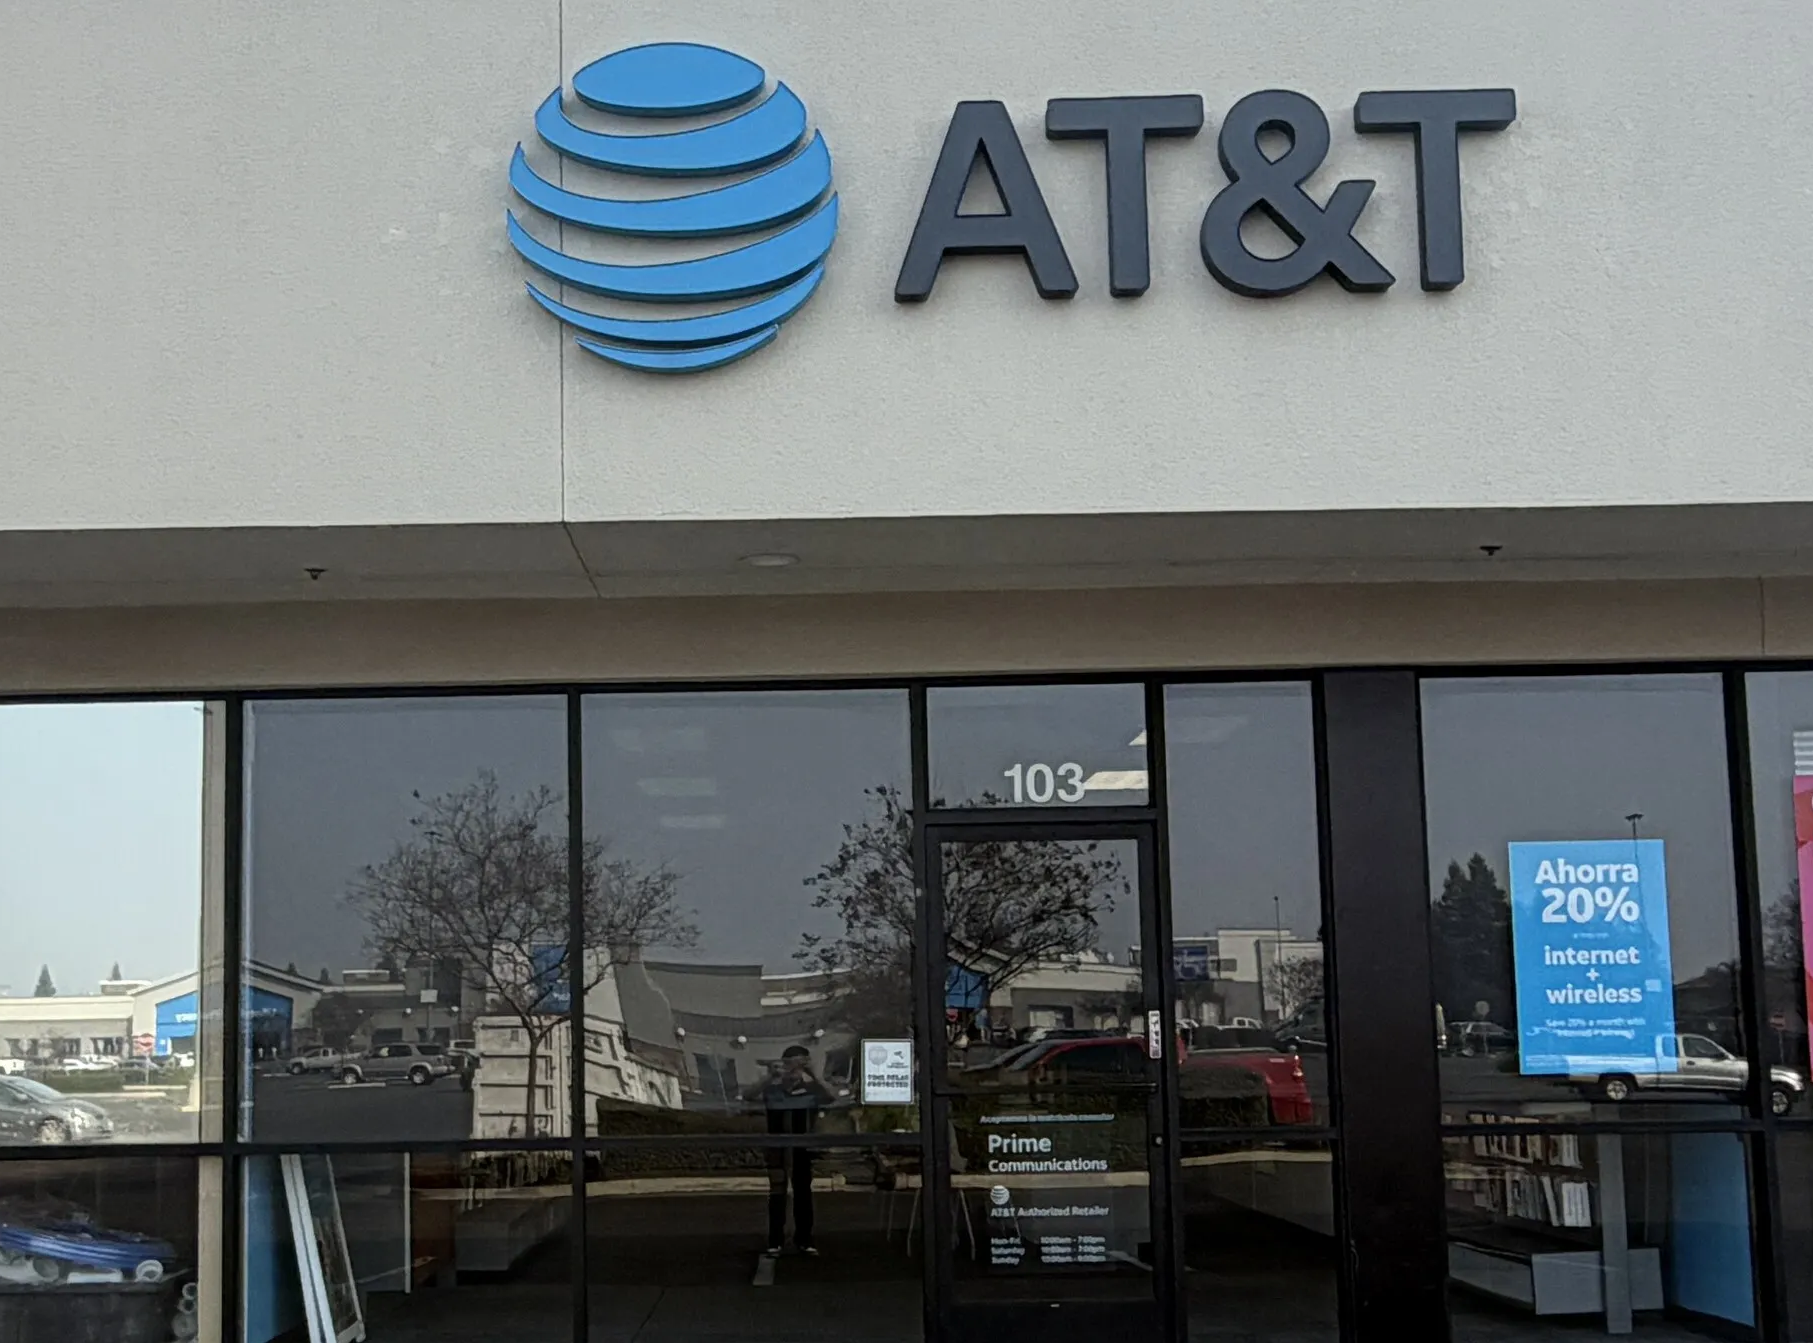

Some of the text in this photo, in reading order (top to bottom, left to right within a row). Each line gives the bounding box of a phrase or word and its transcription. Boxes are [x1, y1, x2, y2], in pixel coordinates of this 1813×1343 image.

[894, 89, 1515, 302] AT&T
[1004, 762, 1085, 803] 103
[1534, 858, 1639, 884] Ahorra
[1541, 886, 1640, 923] 20%
[1544, 945, 1640, 966] internet
[1546, 983, 1643, 1004] wireless
[988, 1133, 1052, 1154] Prime
[988, 1157, 1108, 1173] Communications
[990, 1206, 1110, 1217] AT&T Authorized Retailer
